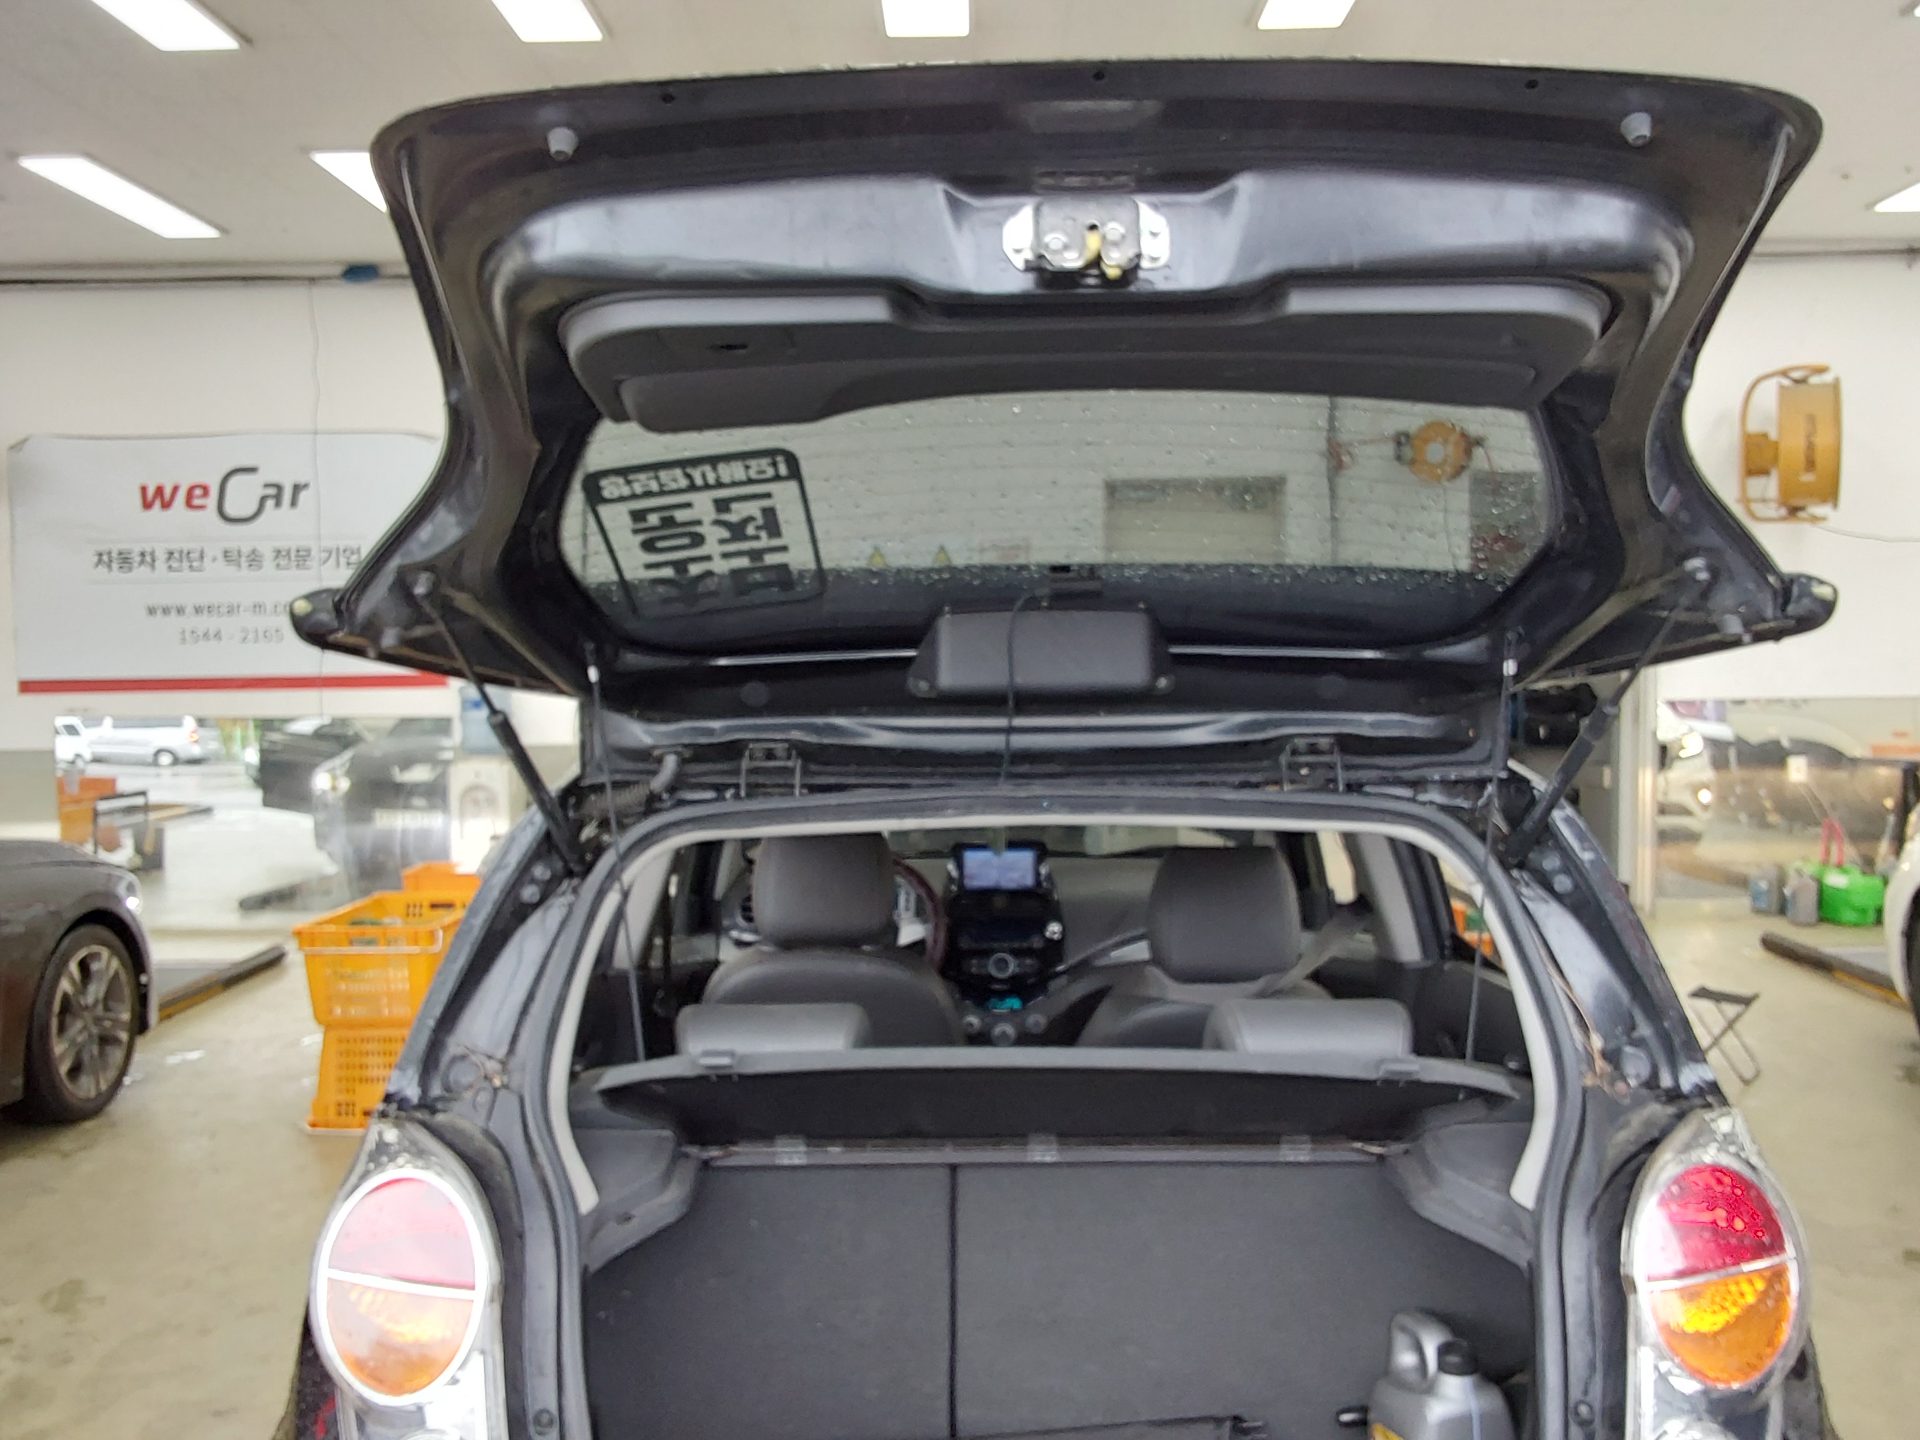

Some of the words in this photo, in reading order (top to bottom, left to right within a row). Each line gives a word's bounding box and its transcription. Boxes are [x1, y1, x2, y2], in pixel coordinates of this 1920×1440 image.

[93, 549, 157, 572] 자동차
[271, 546, 313, 571] 전문
[320, 545, 362, 569] 기업
[145, 602, 292, 618] www.wecar-m.co
